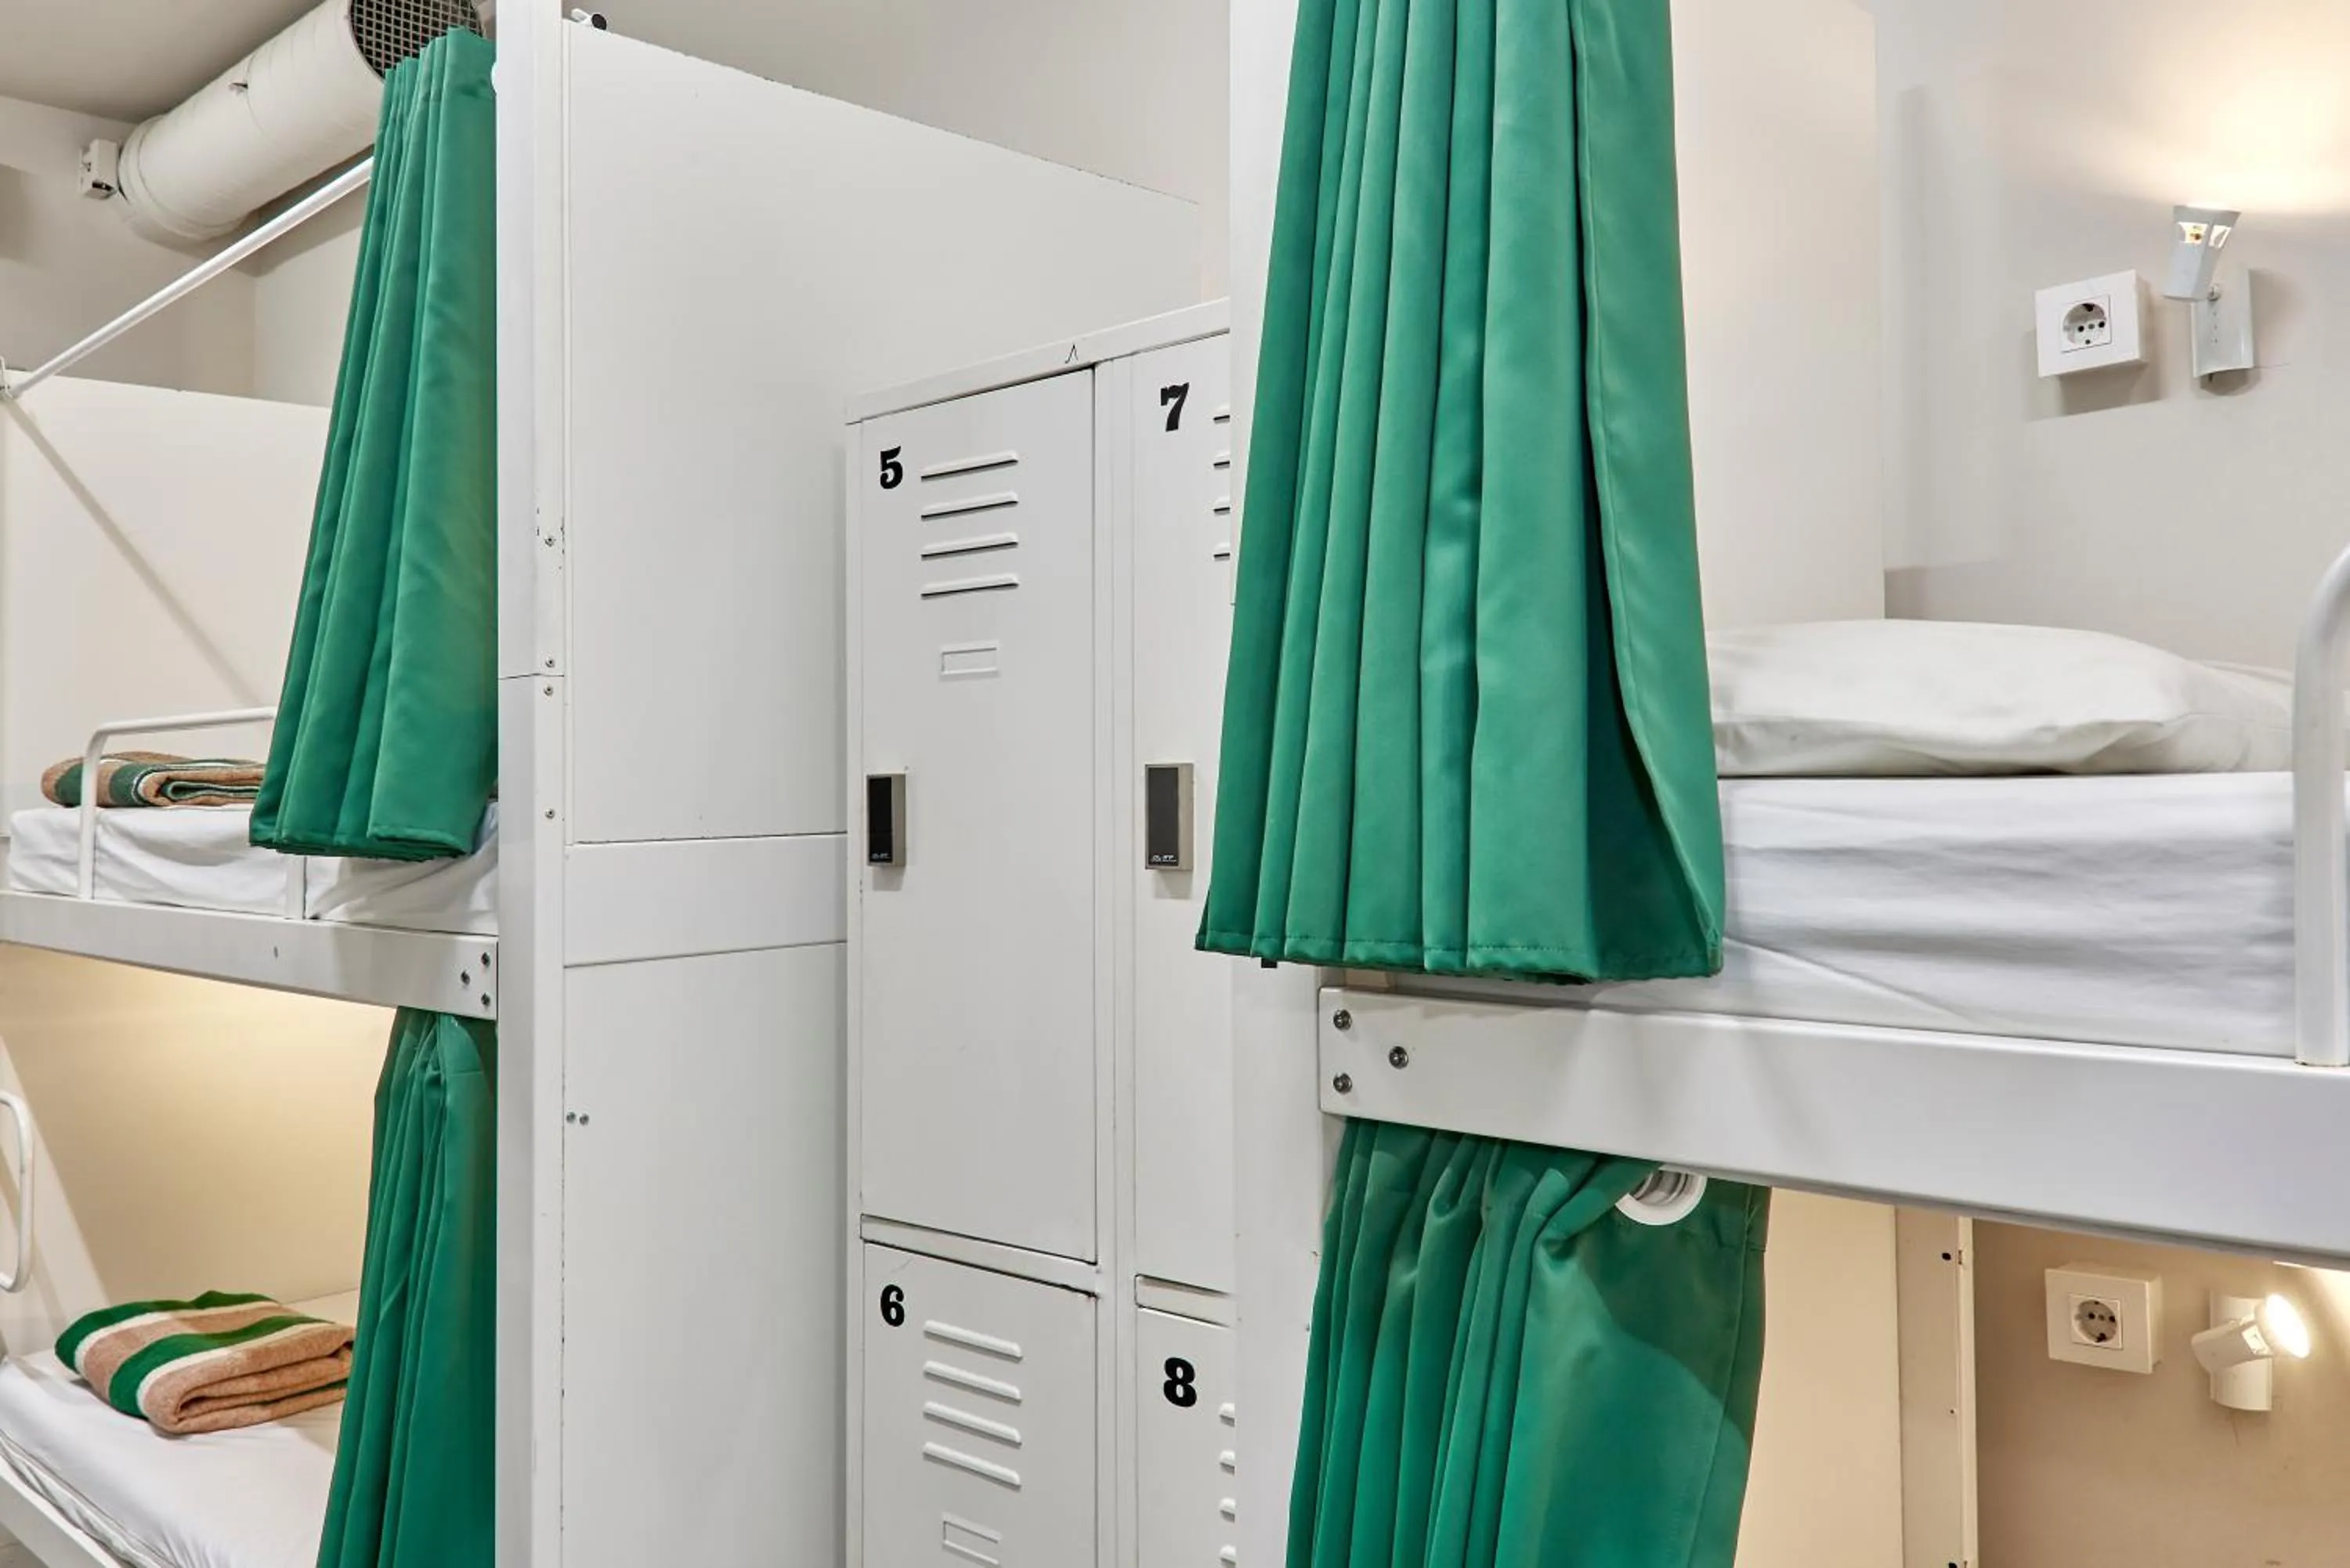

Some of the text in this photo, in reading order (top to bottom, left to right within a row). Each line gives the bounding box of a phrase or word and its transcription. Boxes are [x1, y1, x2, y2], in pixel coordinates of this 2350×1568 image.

[1160, 382, 1190, 432] 7
[880, 446, 903, 490] 5
[880, 1284, 905, 1328] 6
[1163, 1357, 1198, 1408] 8
